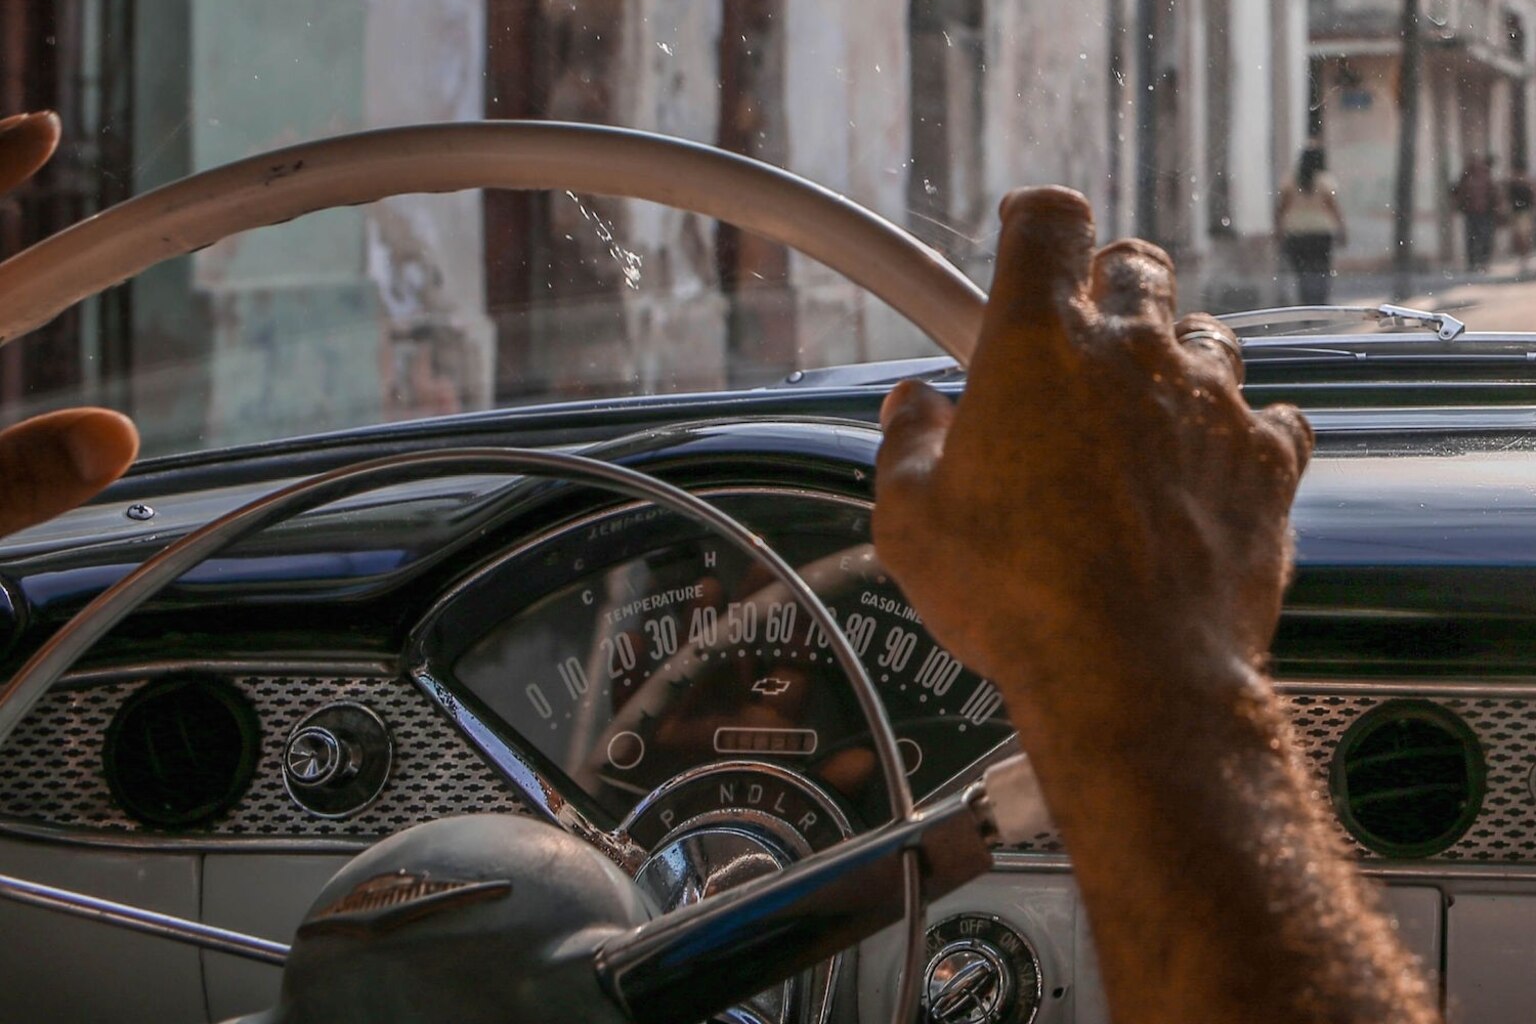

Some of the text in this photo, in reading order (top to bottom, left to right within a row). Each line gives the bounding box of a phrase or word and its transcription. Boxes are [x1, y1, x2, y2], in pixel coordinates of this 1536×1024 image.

[705, 551, 717, 568] H
[582, 589, 594, 606] C
[604, 584, 704, 625] TEMPERATURE
[644, 615, 678, 661] 30
[688, 606, 718, 650] 40
[727, 601, 758, 645] 50
[765, 601, 797, 644] 60
[845, 612, 877, 658] 80
[600, 632, 636, 680] 20
[877, 626, 918, 672] 90
[557, 656, 589, 701] 10
[914, 645, 963, 696] 100
[525, 683, 552, 719] 0
[959, 679, 1003, 726] 110
[720, 784, 735, 804] N
[748, 784, 763, 804] D
[774, 792, 786, 813] L
[659, 809, 675, 830] P
[798, 812, 818, 832] R
[960, 919, 984, 934] OFF
